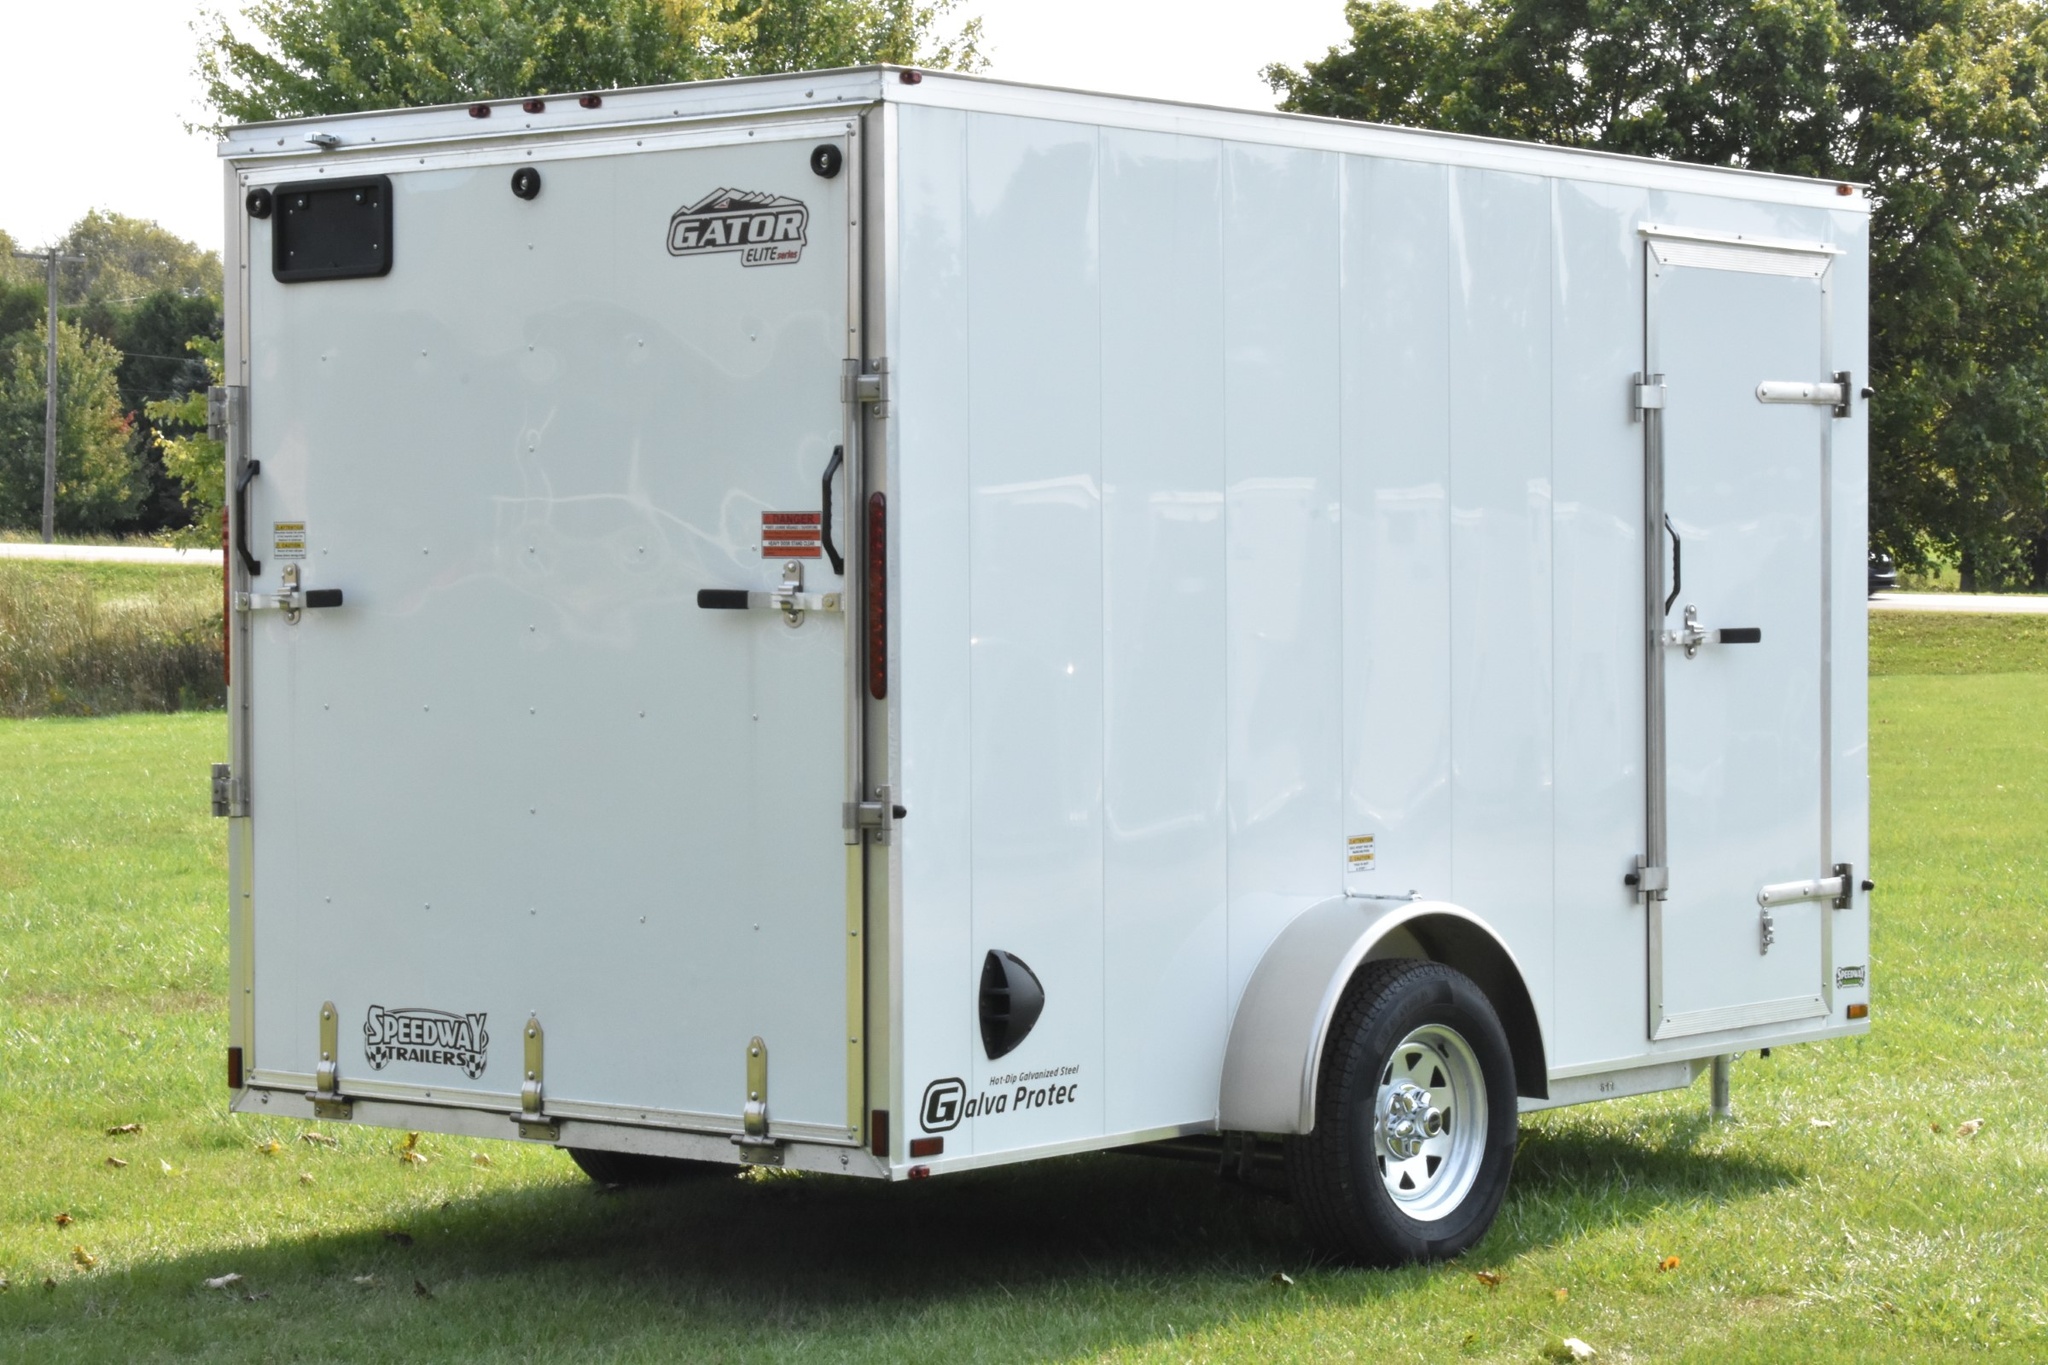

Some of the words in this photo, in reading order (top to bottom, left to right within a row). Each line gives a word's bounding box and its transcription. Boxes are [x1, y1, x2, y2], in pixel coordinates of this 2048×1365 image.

[672, 212, 802, 249] GATOR
[746, 247, 777, 262] ELITE
[776, 250, 798, 260] series
[773, 514, 813, 524] DANGER
[367, 1004, 487, 1054] SPEEDWAY
[385, 1046, 466, 1066] TRAILERS
[989, 1073, 1018, 1086] Hot-Dip
[1019, 1067, 1059, 1082] Galvanized
[1060, 1064, 1079, 1076] Steel
[924, 1085, 1008, 1124] Galva
[1013, 1083, 1078, 1111] Protec
